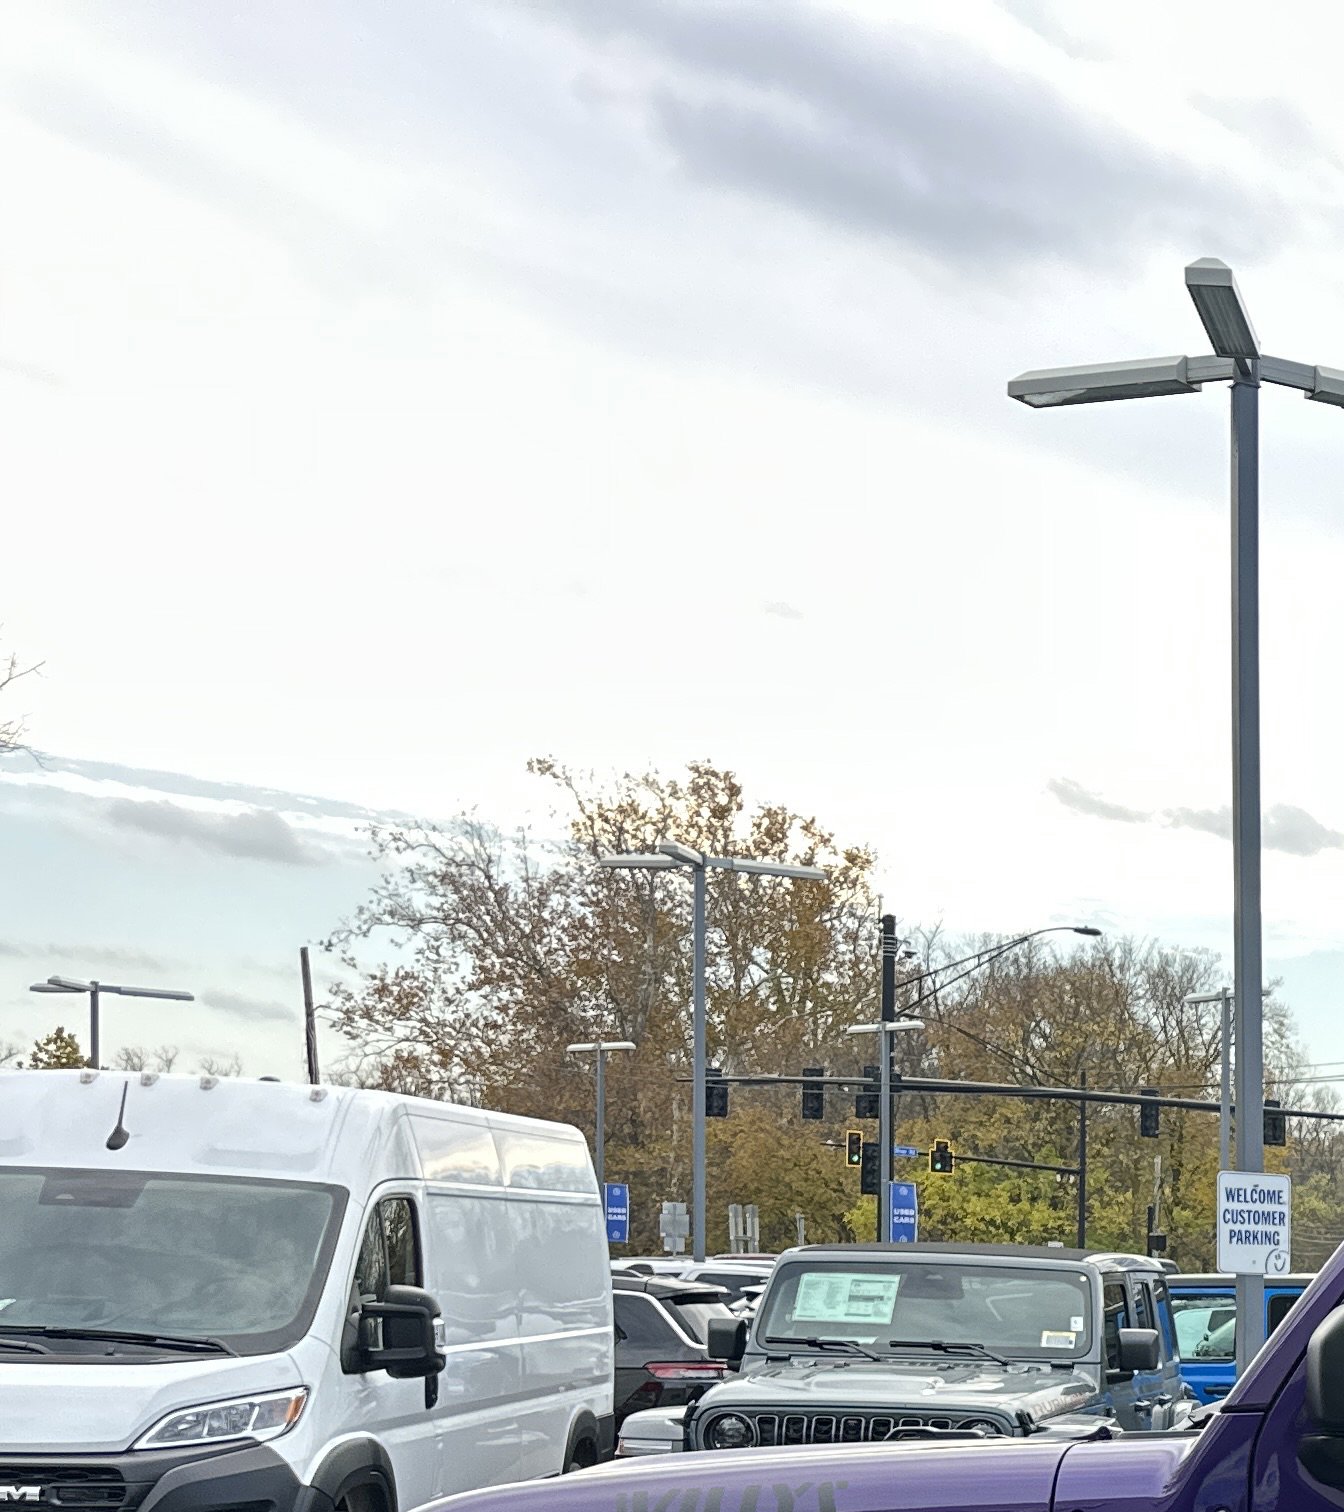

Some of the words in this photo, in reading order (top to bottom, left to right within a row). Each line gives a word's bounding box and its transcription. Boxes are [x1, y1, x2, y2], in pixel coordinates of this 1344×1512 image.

[1224, 1186, 1286, 1205] WELCOME
[893, 1207, 915, 1216] USED
[893, 1216, 915, 1224] CARS
[1222, 1208, 1286, 1227] CUSTOMER
[1228, 1229, 1281, 1246] PARKING
